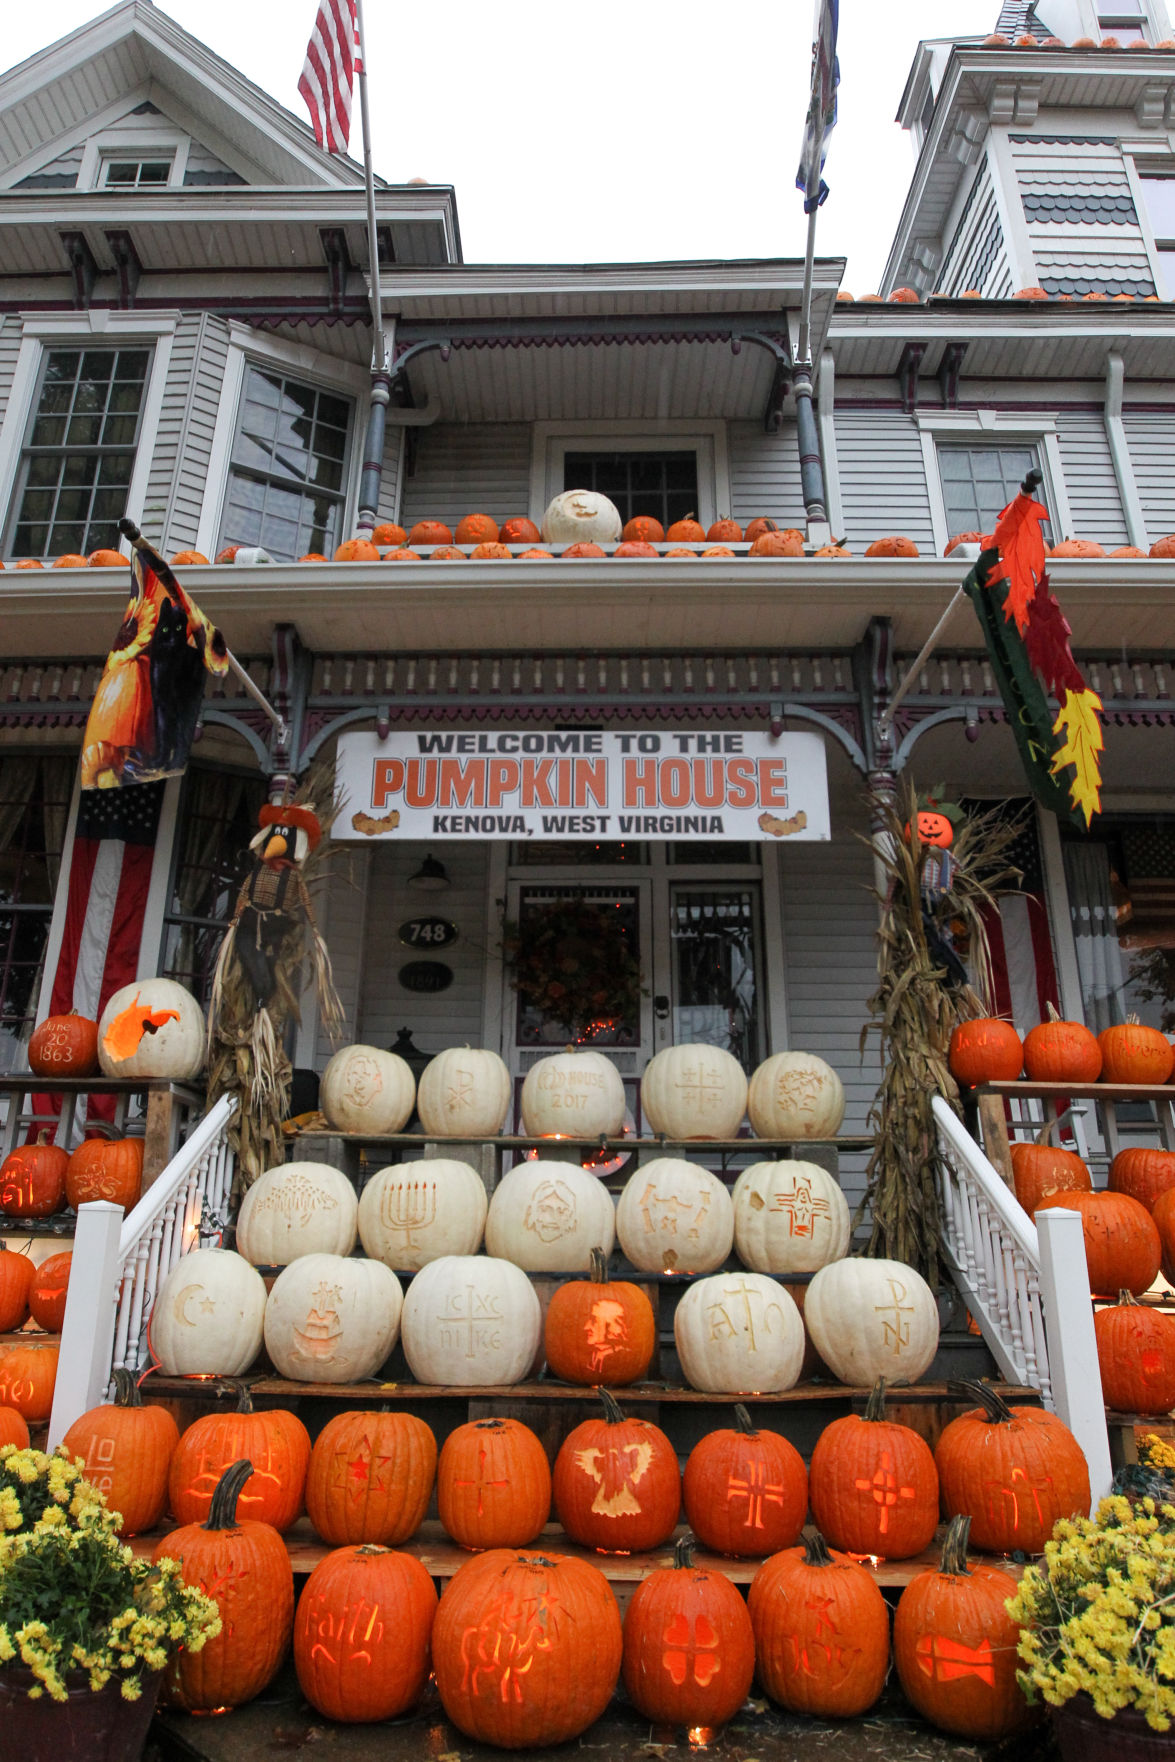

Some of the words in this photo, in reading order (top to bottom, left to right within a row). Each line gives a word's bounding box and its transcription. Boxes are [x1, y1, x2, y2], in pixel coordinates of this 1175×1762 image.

[418, 734, 603, 754] WELCOME
[615, 734, 661, 754] TO
[673, 734, 744, 754] THE
[370, 757, 609, 809] PUMPKIN
[622, 757, 789, 809] HOUSE
[432, 814, 534, 836] KENOVA,
[542, 815, 611, 834] WEST
[618, 815, 725, 834] VIRGINIA
[409, 923, 446, 942] 748
[40, 1021, 72, 1033] June
[47, 1033, 68, 1046] 20
[39, 1045, 73, 1063] 1863
[568, 1071, 606, 1089] HOUSE
[551, 1093, 589, 1110] 2017
[304, 1594, 384, 1644] Faith
